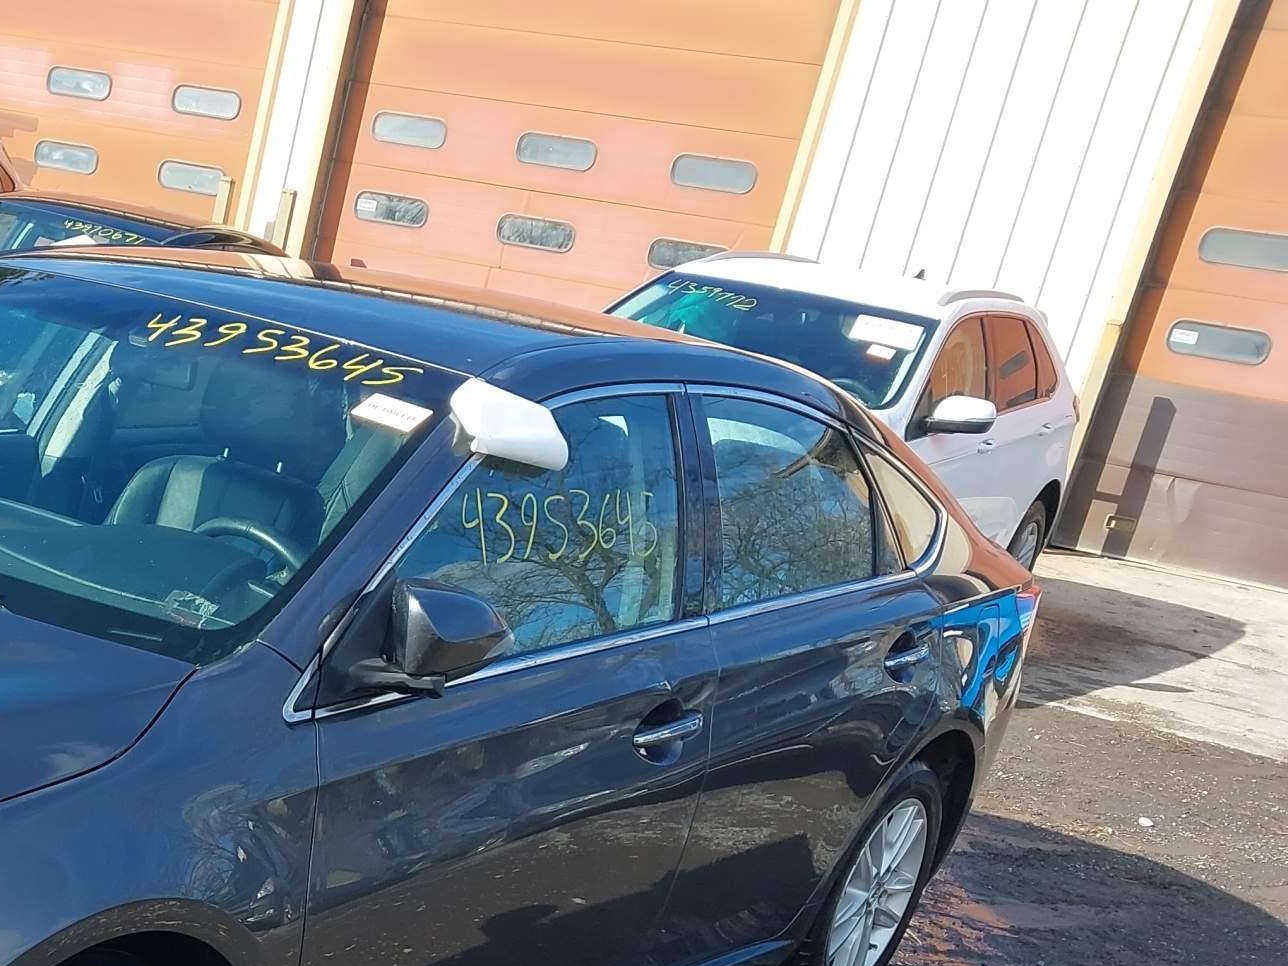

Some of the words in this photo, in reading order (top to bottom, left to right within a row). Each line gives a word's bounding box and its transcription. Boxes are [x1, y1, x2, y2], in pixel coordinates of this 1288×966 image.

[63, 219, 146, 245] 43970671
[146, 313, 425, 385] 43953645
[462, 487, 658, 567] 43953645
